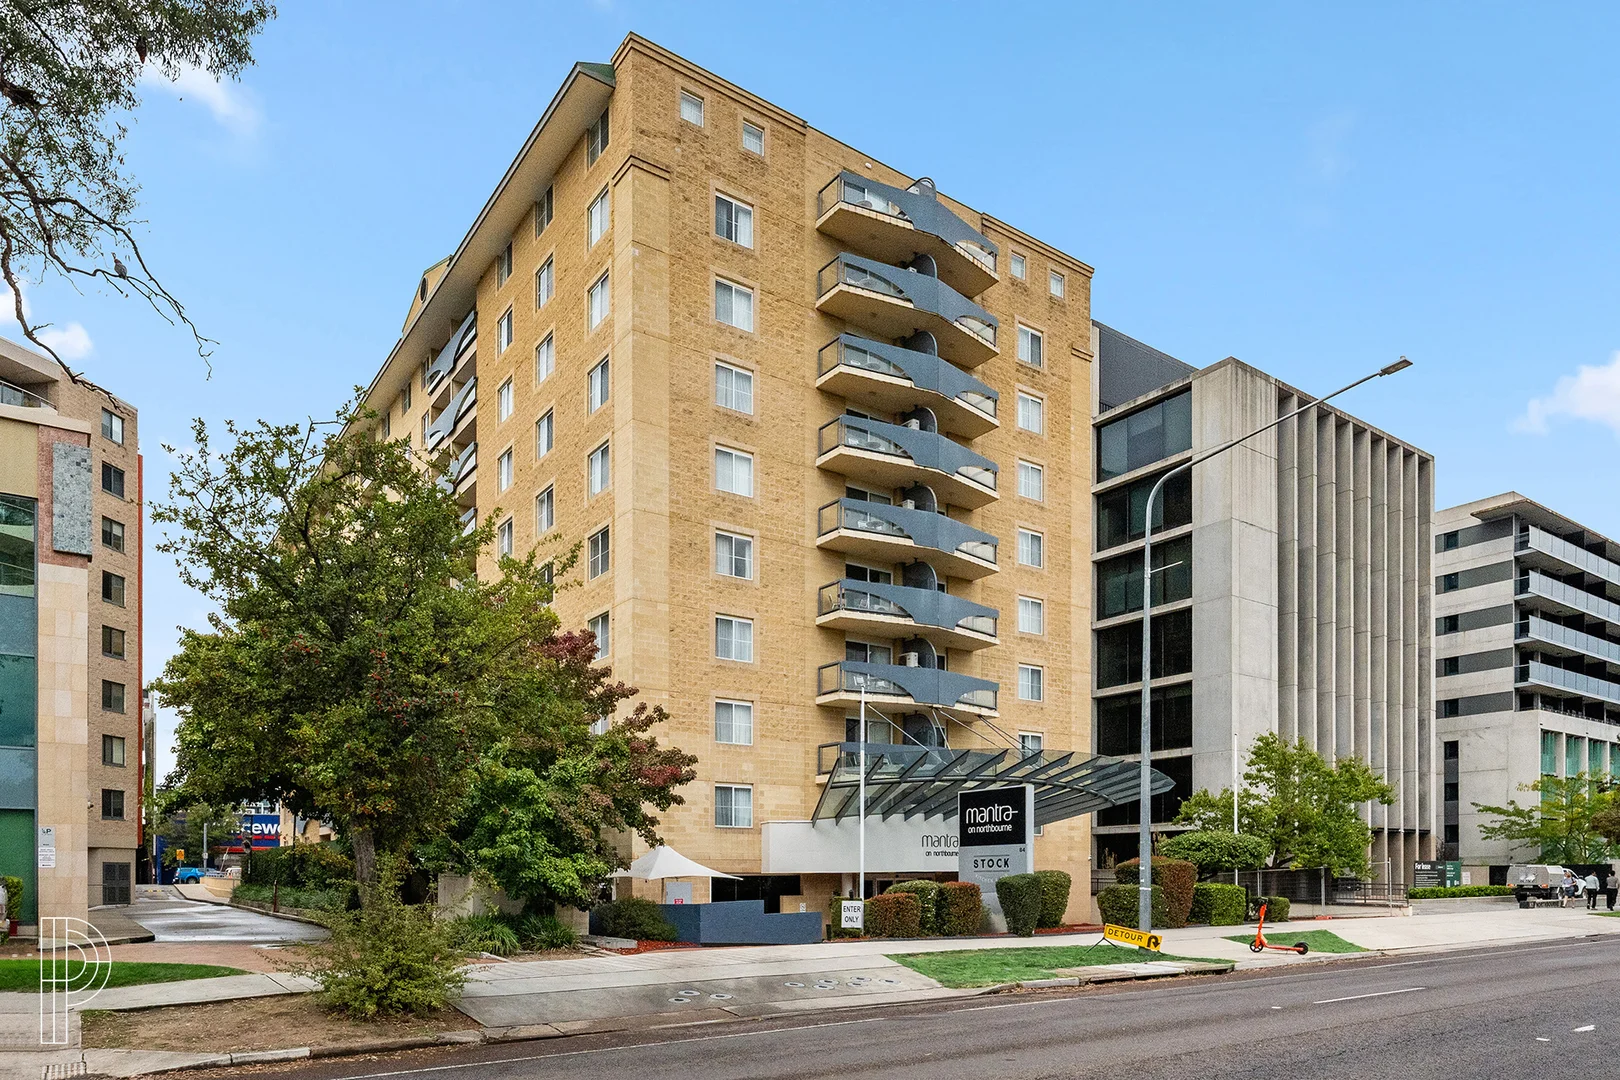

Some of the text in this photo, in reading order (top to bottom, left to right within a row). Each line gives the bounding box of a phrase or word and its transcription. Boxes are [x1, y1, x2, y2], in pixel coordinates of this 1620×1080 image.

[966, 804, 1018, 824] mantra
[968, 824, 1012, 833] on northbourne
[922, 834, 958, 848] mantra
[973, 858, 1009, 869] STOCK
[1108, 928, 1143, 942] DETOUR
